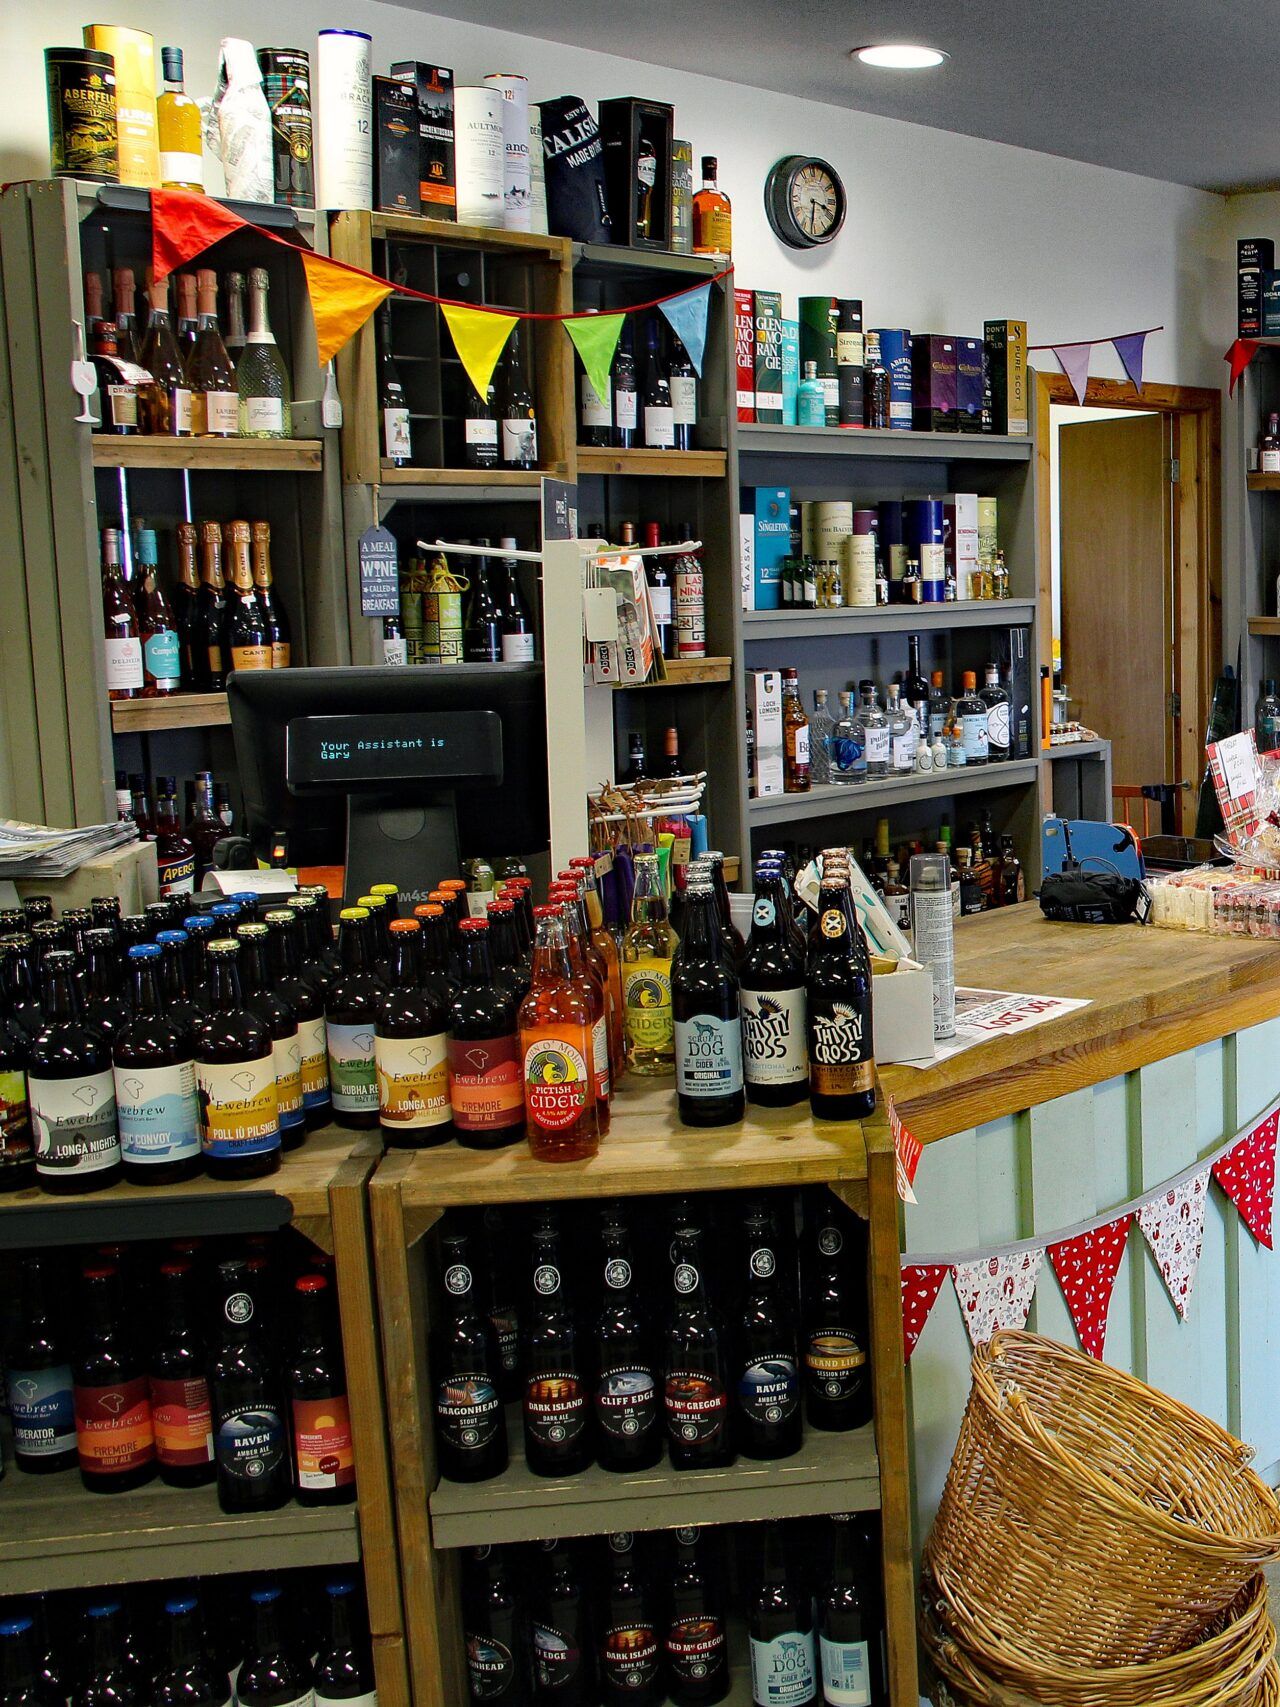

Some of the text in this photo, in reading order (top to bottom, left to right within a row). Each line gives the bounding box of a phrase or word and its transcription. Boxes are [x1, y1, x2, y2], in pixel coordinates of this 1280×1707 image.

[357, 120, 369, 134] 12
[566, 147, 592, 168] MADE
[756, 316, 781, 331] GLEN
[738, 330, 754, 343] MO
[766, 331, 782, 344] MO
[756, 343, 777, 356] RAN
[737, 355, 753, 368] GIE
[765, 358, 781, 370] GIE
[758, 521, 789, 532] SINGLETON
[362, 542, 396, 552] A MEAL
[259, 551, 267, 577] CANTI
[760, 568, 769, 578] 12
[369, 585, 391, 593] CALLED
[362, 599, 398, 611] BREAKFAST
[321, 737, 444, 753] Your Assistant is
[321, 750, 350, 760] Gary
[813, 1020, 863, 1045] THISTLY
[688, 1042, 725, 1057] DOG
[815, 1041, 863, 1064] CROSS
[695, 1061, 714, 1069] CIDER
[393, 1071, 446, 1084] Ewebrew
[455, 1072, 507, 1085] Ewebrew
[694, 1071, 721, 1079] ORIGINAL
[341, 1085, 366, 1096] RUBHA
[535, 1086, 572, 1095] PICTISH
[215, 1096, 273, 1111] Ewebrew
[398, 1095, 446, 1111] LONGA DAYS
[462, 1100, 502, 1112] FIREMORE
[530, 1094, 581, 1109] CIDER
[56, 1109, 114, 1128] Ewebrew
[468, 1112, 496, 1121] RUBY ALE
[557, 1110, 576, 1125] BERRY
[213, 1120, 277, 1140] POLL PILSNER
[136, 1132, 171, 1145] CONVOY
[57, 1134, 117, 1157] LONGA NIGHTS
[808, 1357, 860, 1368] ISLAND LIFE
[756, 1381, 788, 1393] RAVEN
[601, 1390, 654, 1405] CLIFF EDGE
[686, 1398, 721, 1410] GREGOR
[758, 1395, 777, 1403] AMBER
[438, 1400, 499, 1416] DRAGONHEAD
[528, 1398, 583, 1412] DARK ISLAND
[86, 1413, 143, 1430] Ewebrew
[459, 1418, 478, 1426] STOUT
[234, 1433, 270, 1447] RAVEN
[94, 1440, 138, 1456] FIREMORE
[237, 1446, 269, 1457] AMBER ALE
[120, 1455, 132, 1463] ALE
[668, 1634, 724, 1651] RED GREGOR
[543, 1651, 567, 1660] EDGE
[606, 1645, 657, 1661] DARK ISLAND
[685, 1653, 700, 1661] RUBY
[773, 1654, 806, 1673] DOG
[781, 1674, 798, 1683] CIDER
[779, 1682, 804, 1693] ORIGINAL
